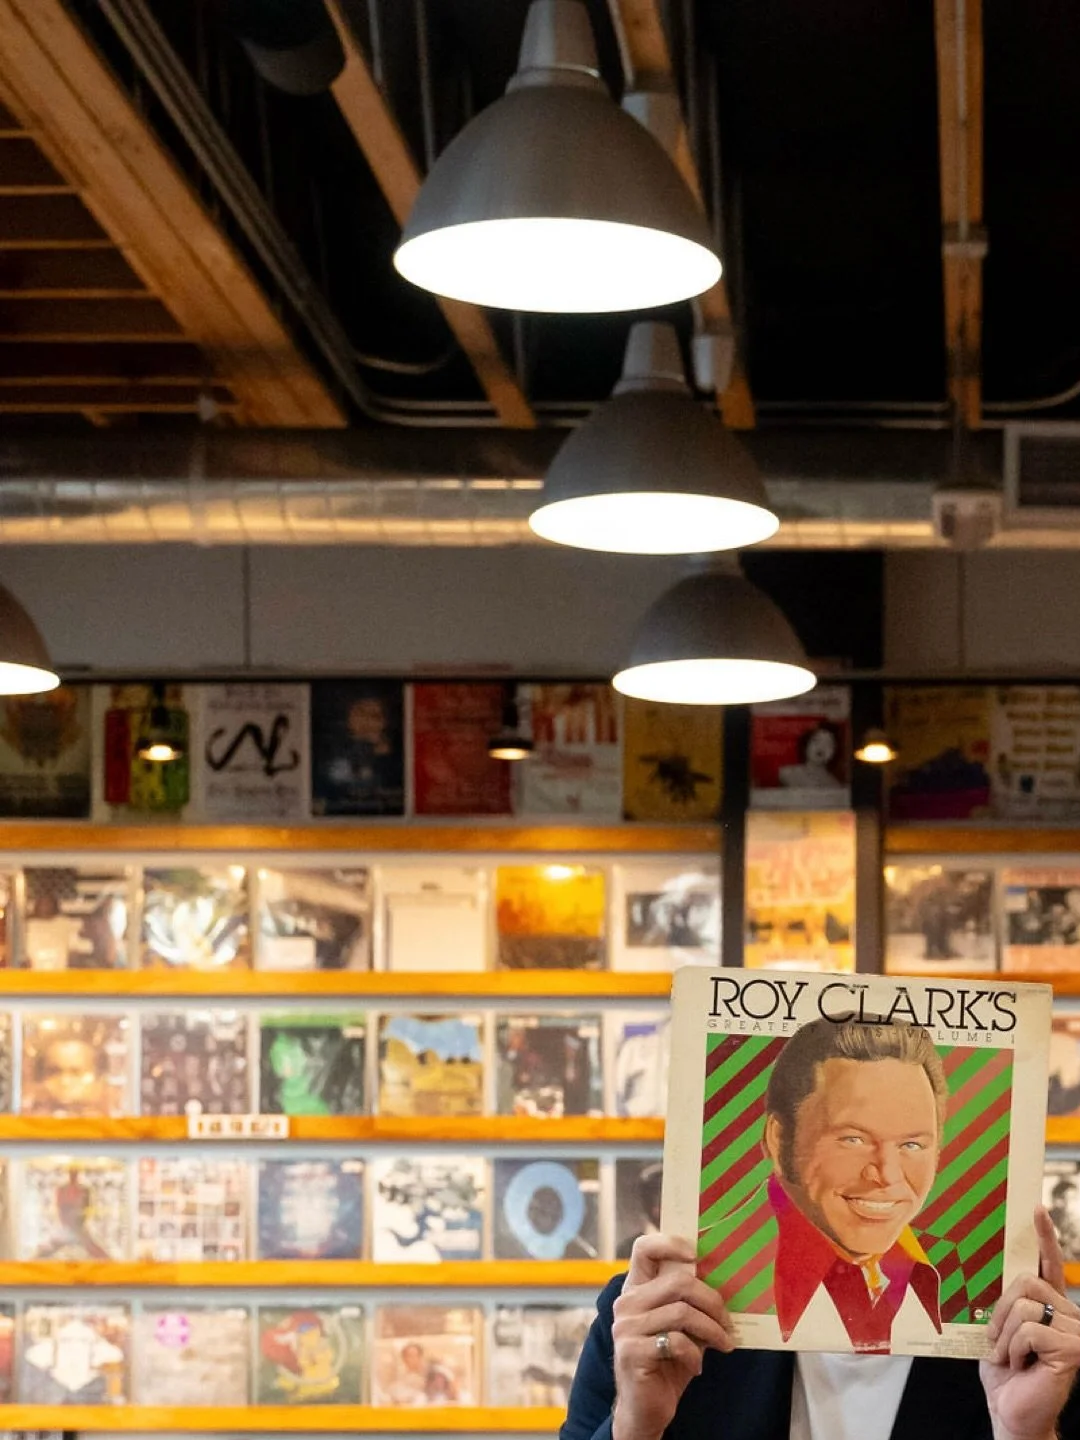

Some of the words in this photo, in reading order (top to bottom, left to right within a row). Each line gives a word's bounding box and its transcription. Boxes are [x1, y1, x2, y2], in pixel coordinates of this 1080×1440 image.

[707, 976, 809, 1020] ROY
[817, 982, 1018, 1033] CLARK'S
[906, 1028, 993, 1042] VOLUME
